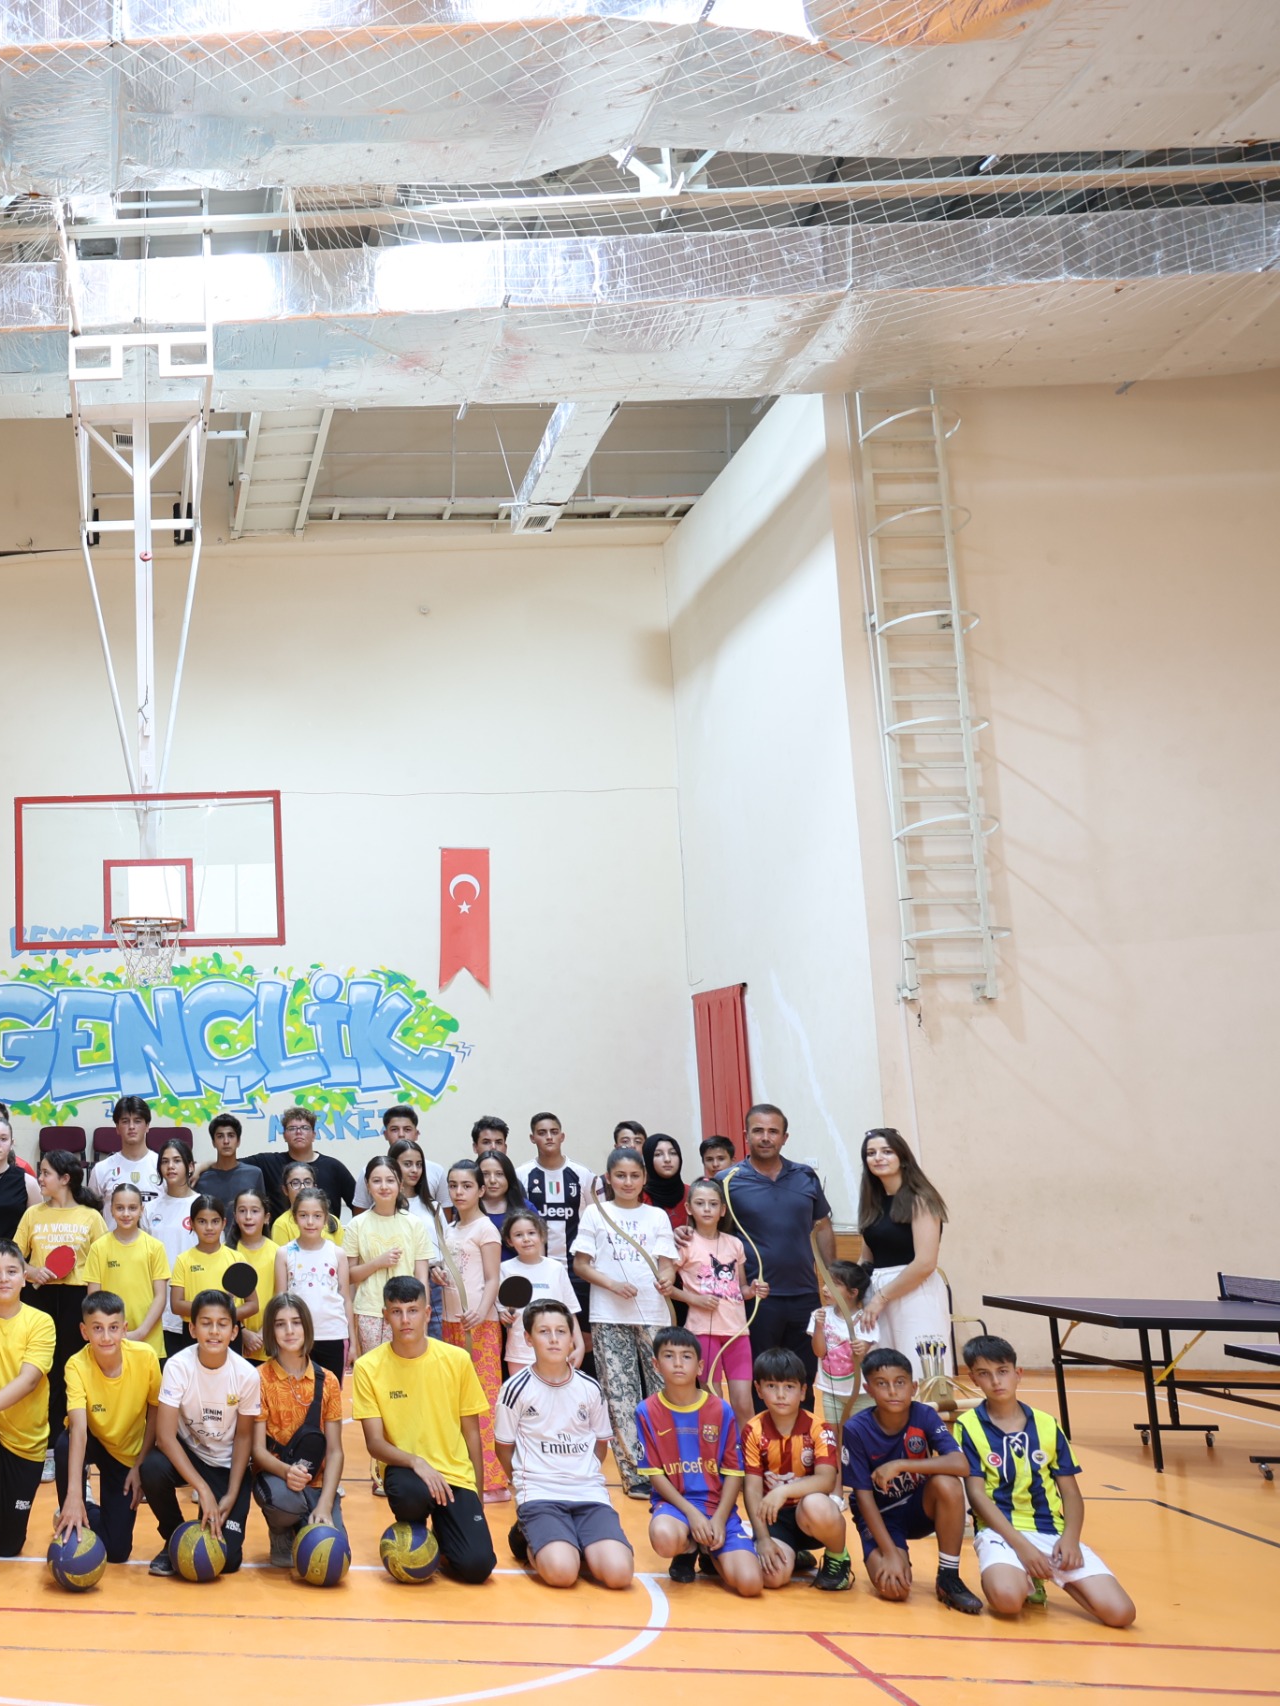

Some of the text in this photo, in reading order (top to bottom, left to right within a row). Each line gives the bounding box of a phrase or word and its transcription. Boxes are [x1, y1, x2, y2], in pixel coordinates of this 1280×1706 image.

[538, 1204, 574, 1220] Jeep
[51, 1223, 78, 1233] WORLD
[557, 1432, 572, 1442] Fly
[541, 1441, 589, 1454] Emirates
[663, 1458, 702, 1475] unicef
